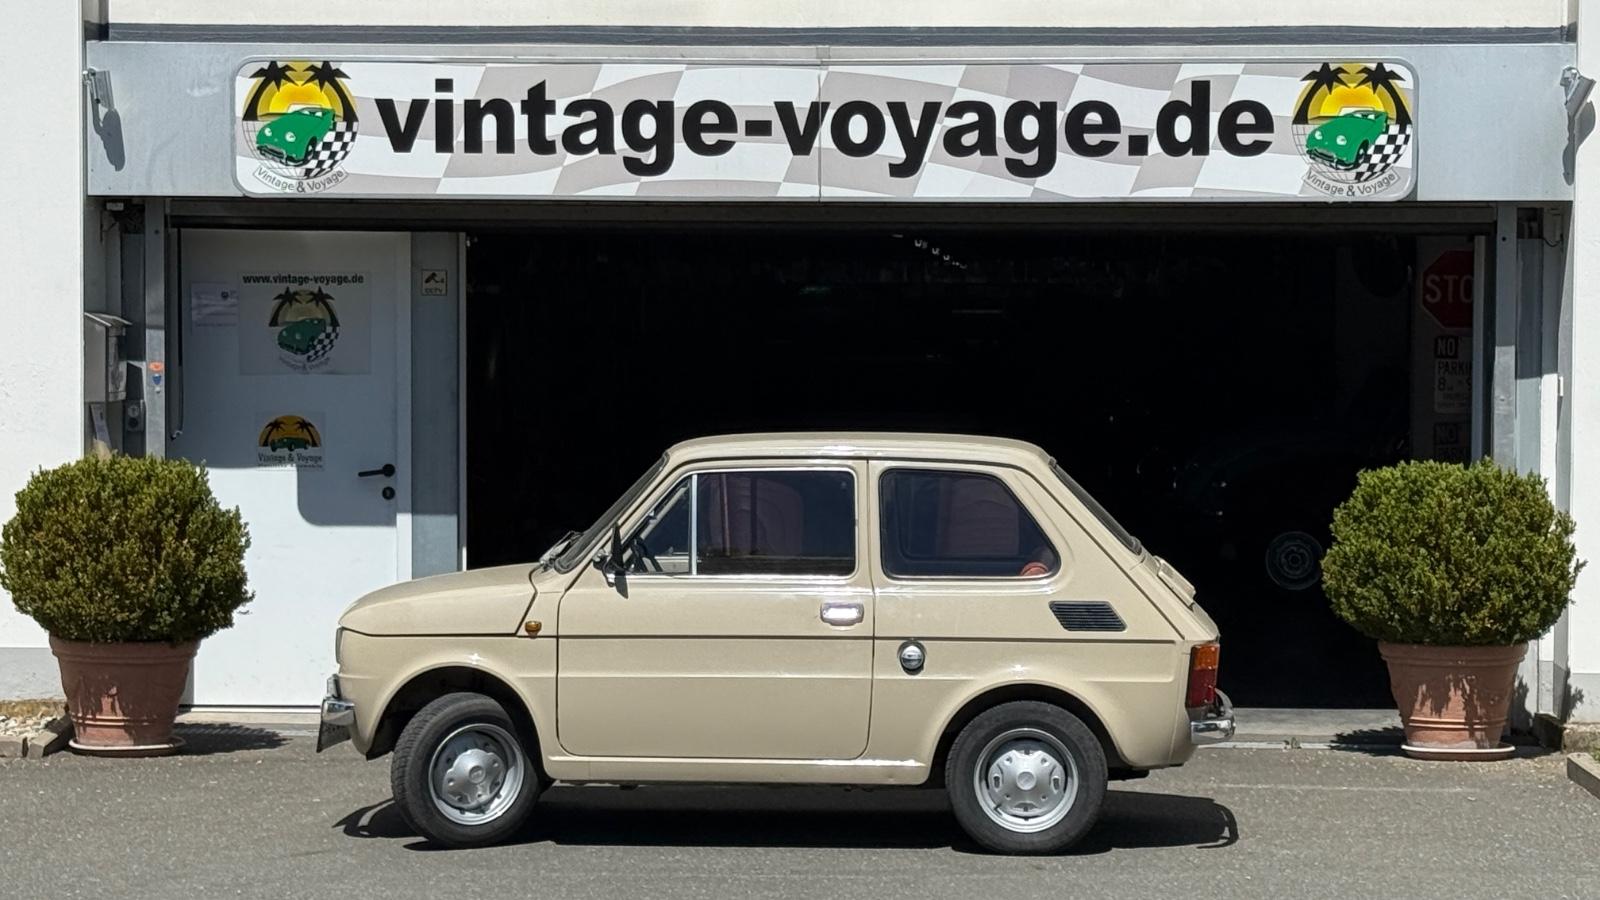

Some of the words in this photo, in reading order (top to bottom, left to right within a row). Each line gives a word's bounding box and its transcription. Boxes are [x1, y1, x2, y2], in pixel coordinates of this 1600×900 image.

[374, 78, 1275, 178] vintage-voyage.de
[257, 167, 295, 191] Vintage
[296, 181, 306, 193] &
[307, 170, 344, 191] Voyage
[1307, 170, 1344, 195] Vintage
[1346, 185, 1355, 197] &
[1357, 173, 1396, 194] Voyage
[242, 273, 364, 286] www.vintage-voyage.de
[1425, 273, 1473, 304] STO
[1437, 337, 1456, 357] NO
[1438, 360, 1472, 376] PARKI
[258, 452, 286, 464] Vintage
[287, 453, 294, 462] &
[296, 452, 322, 464] Voyage
